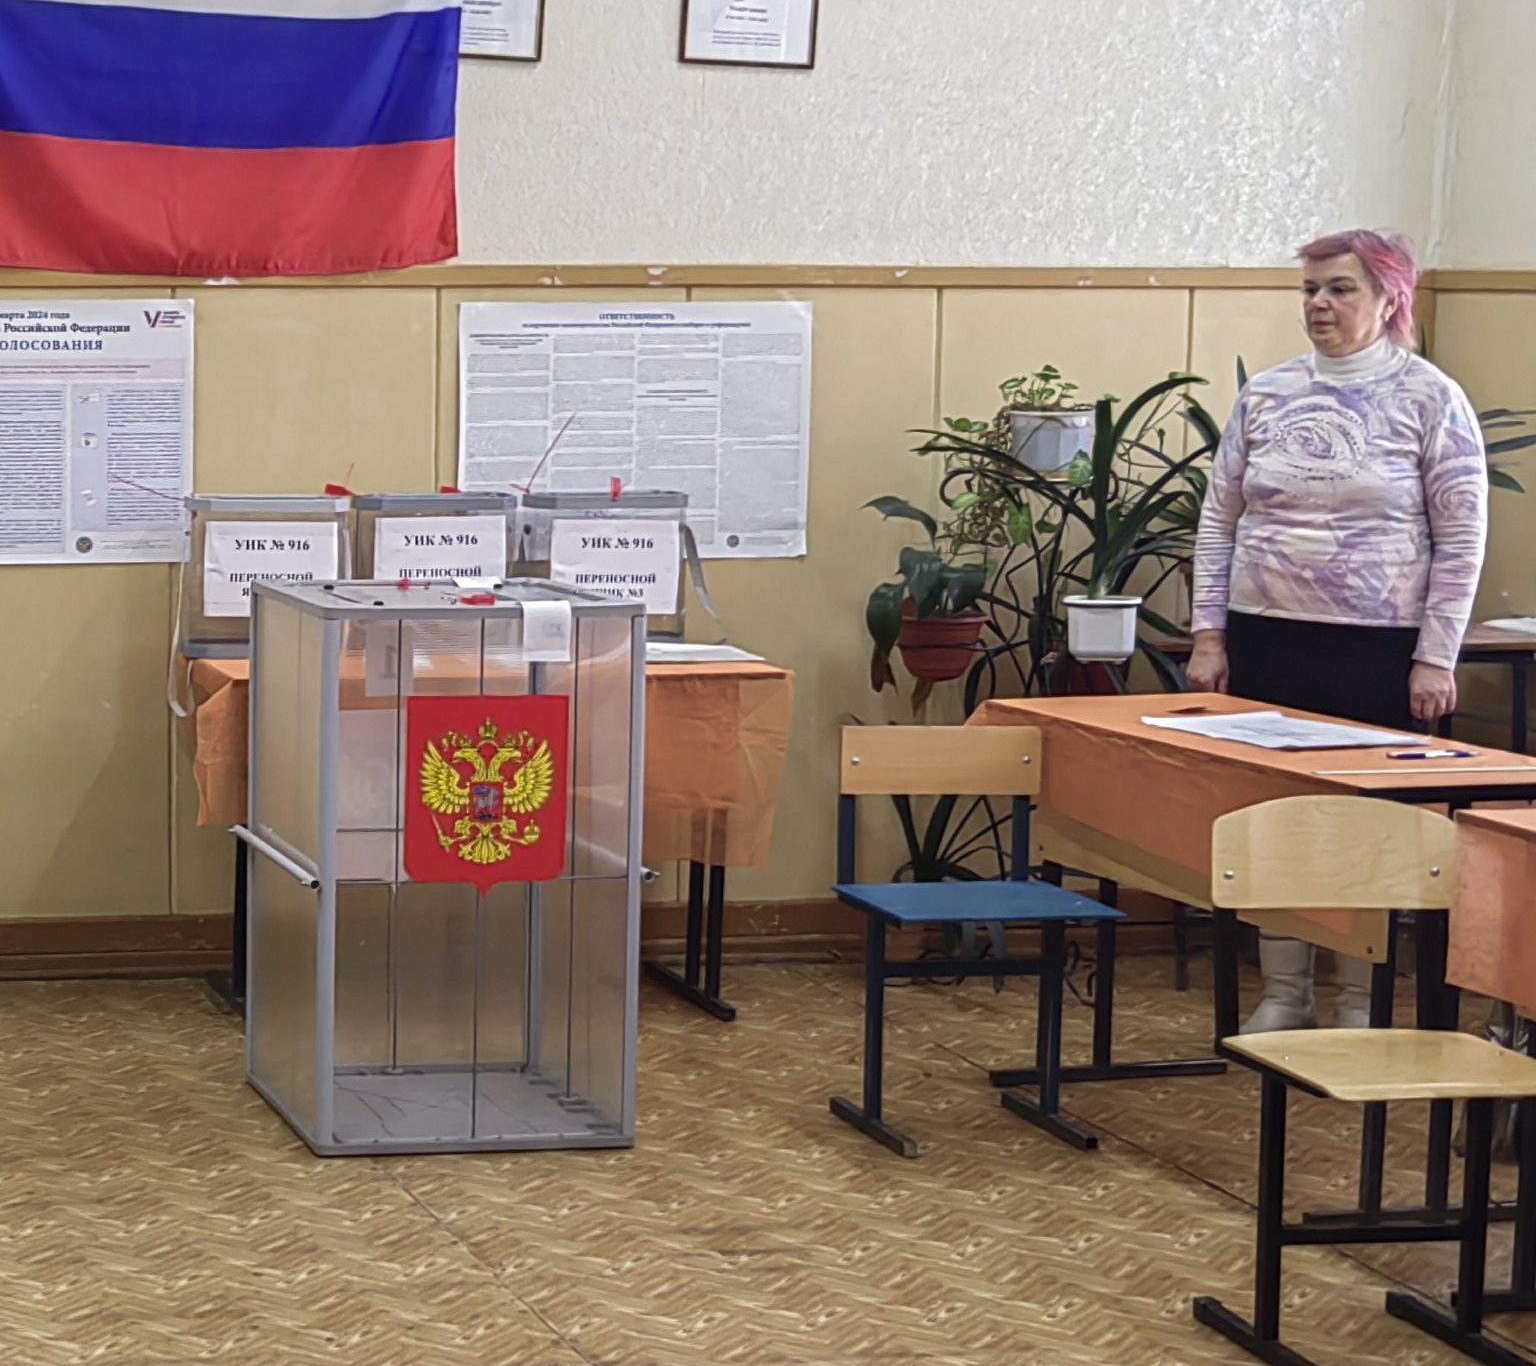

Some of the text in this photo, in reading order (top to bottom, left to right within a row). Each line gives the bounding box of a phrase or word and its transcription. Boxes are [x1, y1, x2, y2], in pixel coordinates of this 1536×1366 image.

[26, 311, 48, 319] 2024
[4, 322, 68, 333] Российской
[70, 322, 131, 335] Федерации
[235, 539, 310, 551] УИК № 916
[404, 533, 478, 546] УИК № 916
[581, 537, 653, 549] УИК № 916
[399, 565, 482, 578] ПЕРЕНОСНОЙ
[576, 572, 656, 584] ПЕРЕНОСНОЙ
